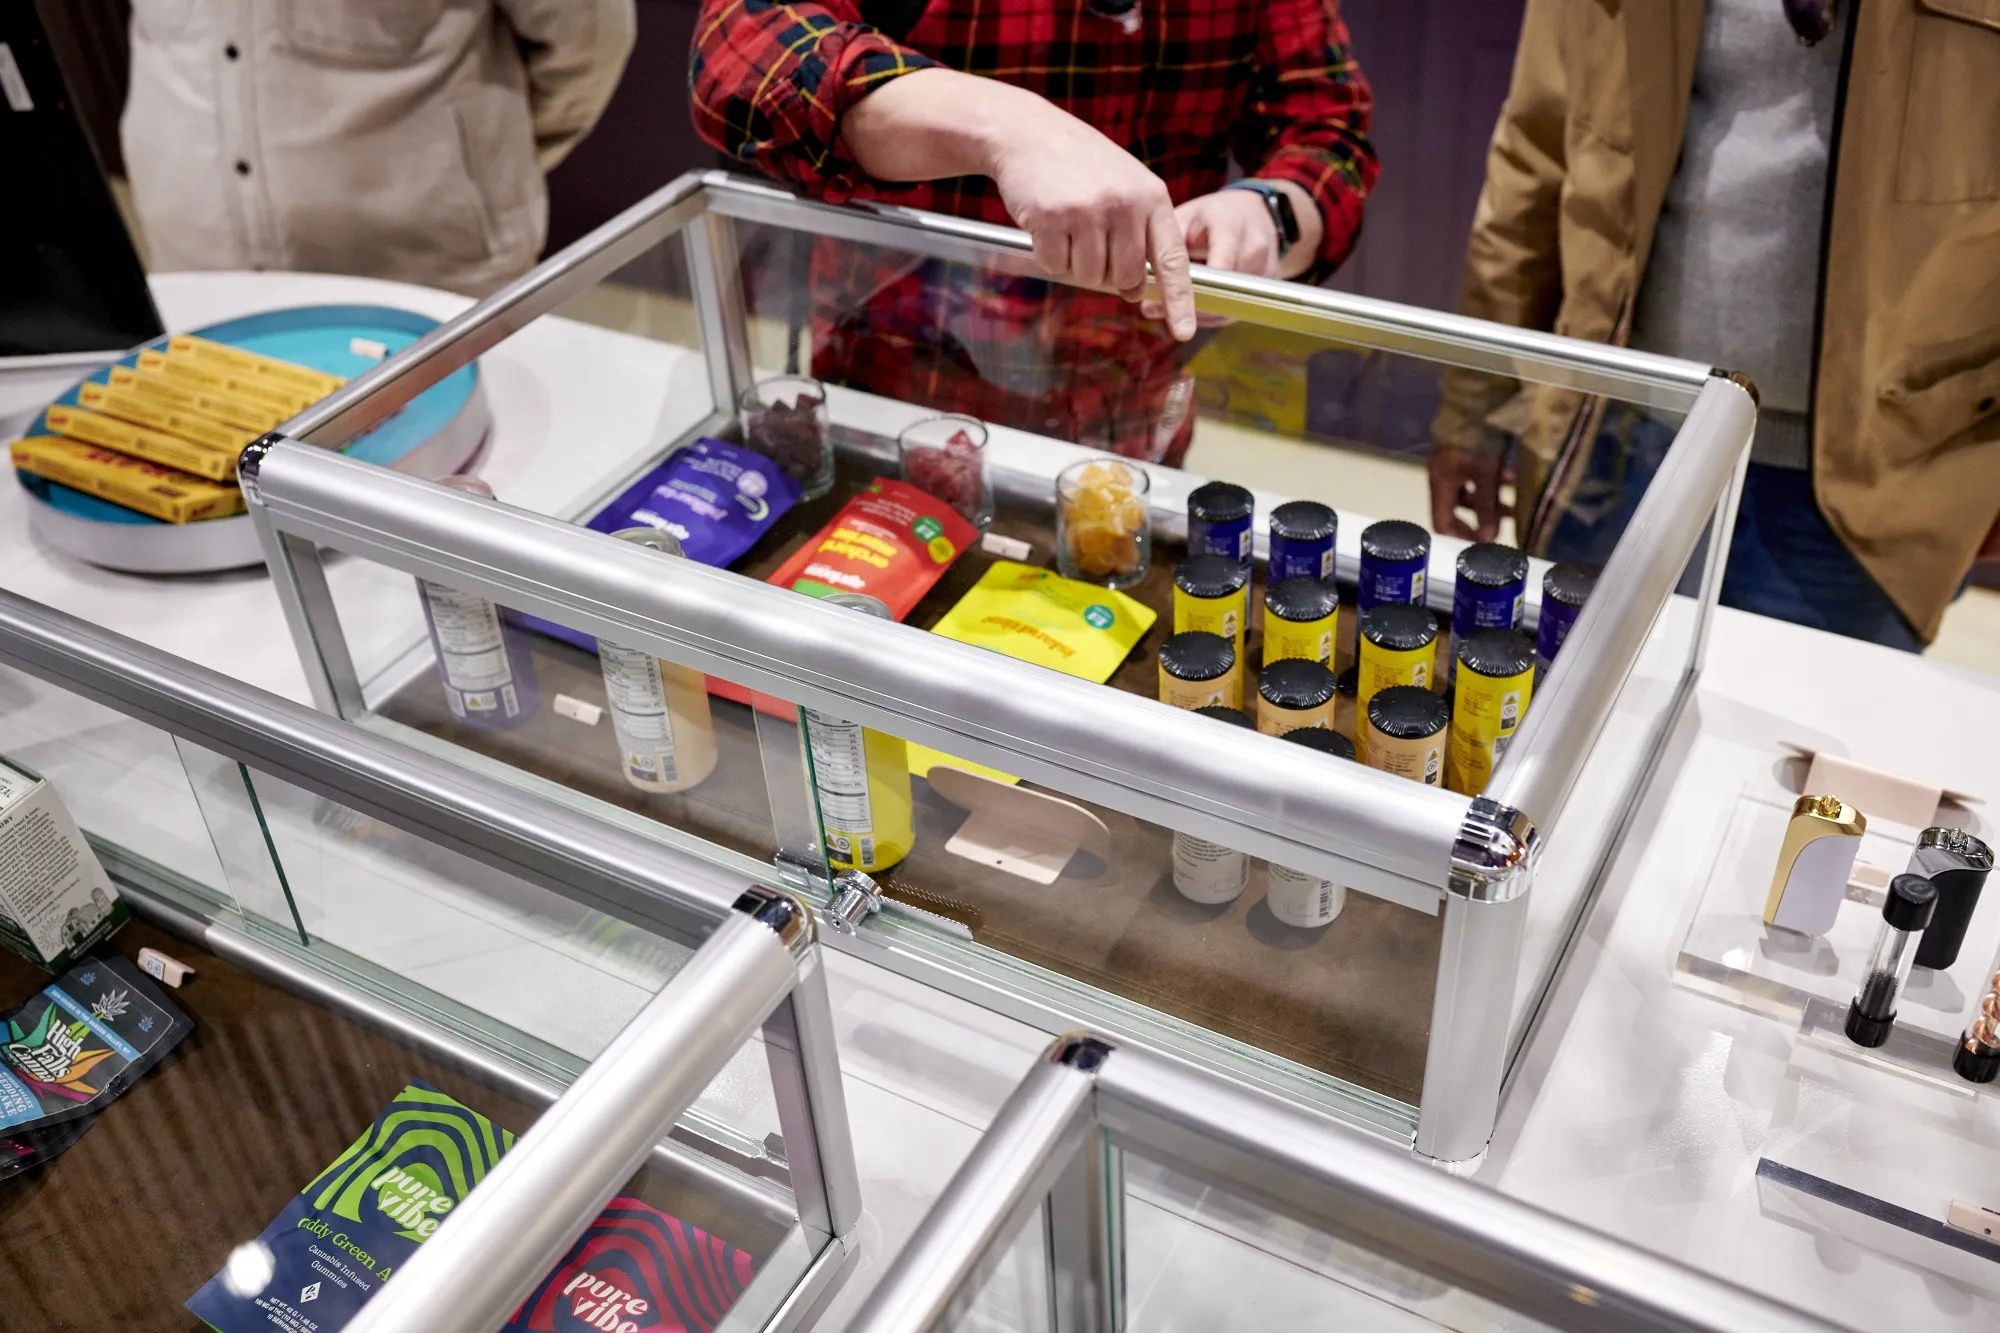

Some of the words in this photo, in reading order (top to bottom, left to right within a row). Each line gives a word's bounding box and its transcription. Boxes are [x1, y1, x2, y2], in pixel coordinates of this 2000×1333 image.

[46, 1019, 84, 1060] High
[9, 1044, 55, 1082] Canna
[31, 1044, 71, 1078] Falls
[19, 1089, 34, 1109] VALLEY
[371, 1167, 453, 1213] pure
[379, 1190, 439, 1237] vibe
[308, 1244, 342, 1269] Cannabis
[340, 1264, 371, 1292] Infused
[332, 1233, 377, 1271] Green
[310, 1260, 348, 1290] Gummies
[563, 1272, 648, 1315] pure
[573, 1297, 639, 1333] vibe
